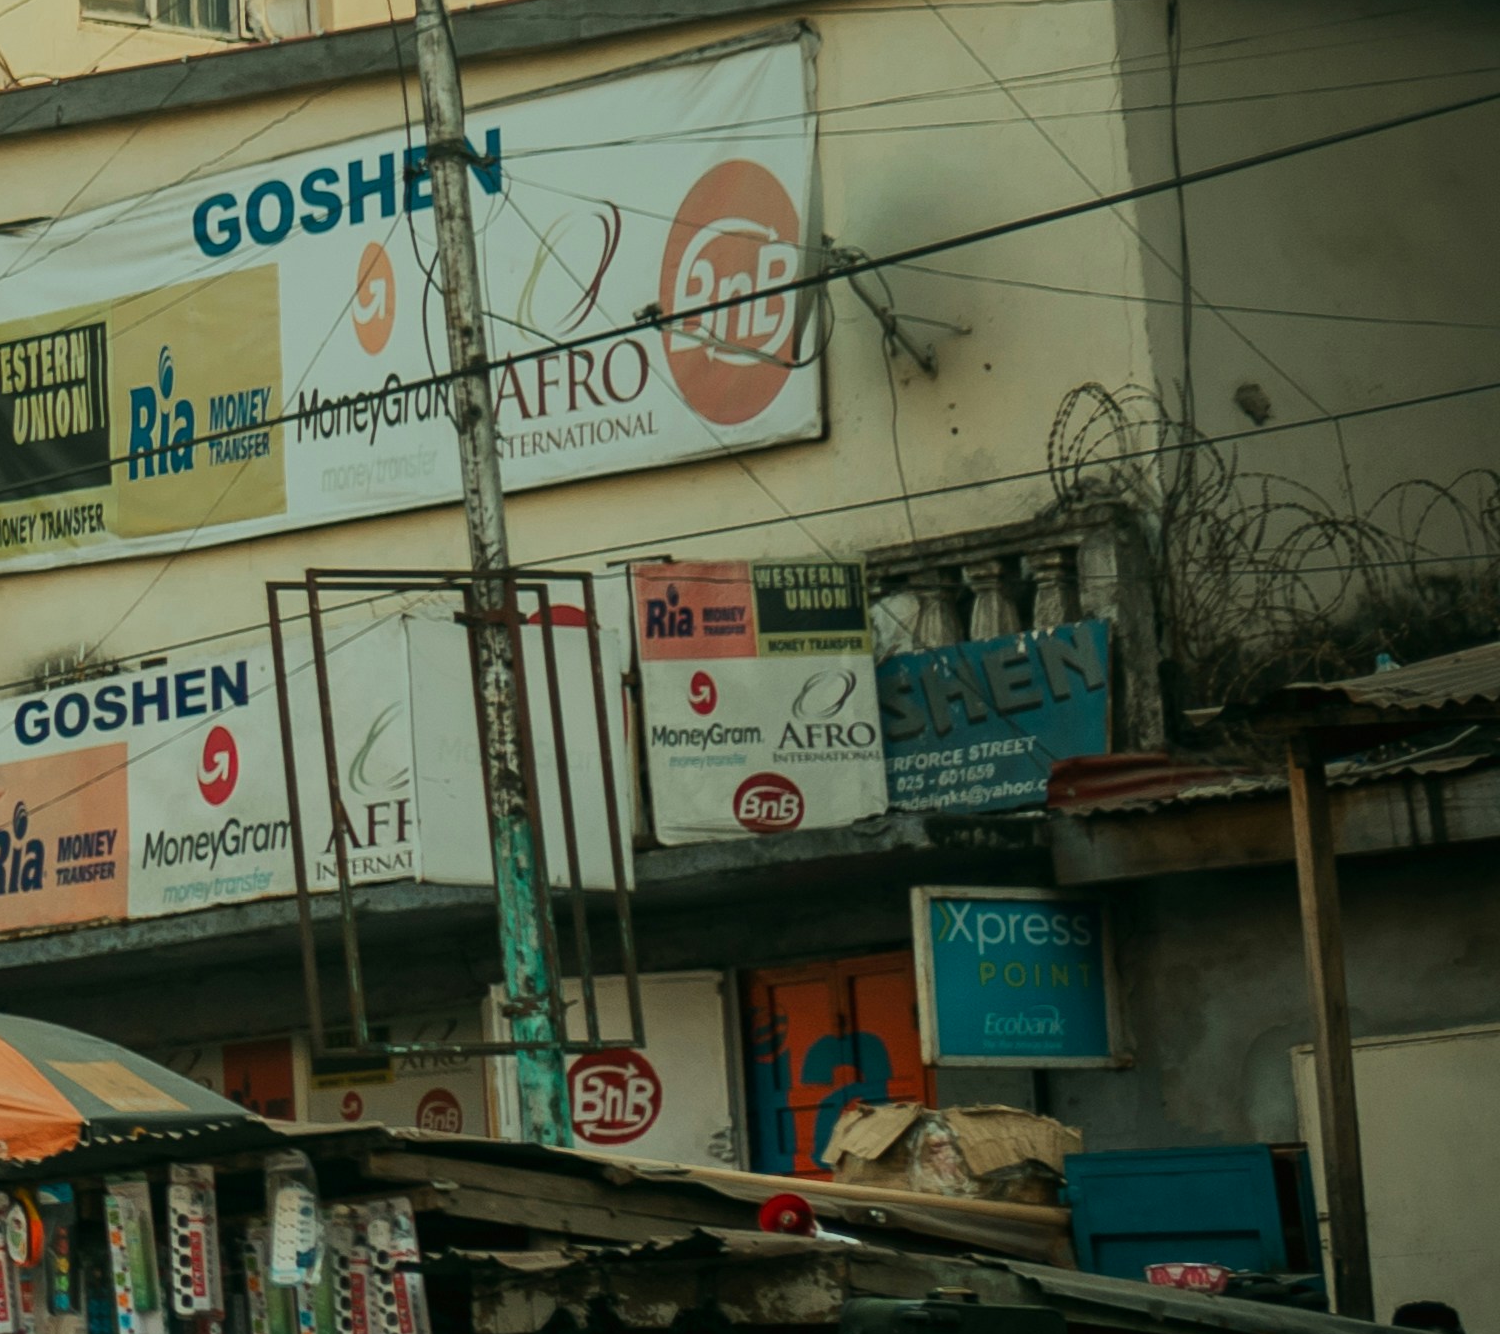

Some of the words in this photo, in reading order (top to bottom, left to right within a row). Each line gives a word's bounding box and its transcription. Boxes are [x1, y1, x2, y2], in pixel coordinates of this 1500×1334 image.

[668, 241, 800, 355] BnB
[494, 338, 651, 423] AFRO
[12, 378, 88, 446] UNION
[128, 365, 195, 482] Ria
[208, 386, 272, 431] MONEY
[208, 431, 270, 467] TRANSFER
[494, 409, 660, 461] NTERNATIONAL
[39, 503, 106, 539] TRANSFER
[754, 565, 846, 589] WESTERN
[646, 589, 695, 639] Ria
[702, 606, 746, 623] MONEY
[785, 586, 847, 611] UNION
[768, 638, 806, 653] MONEY
[807, 634, 864, 652] TRANSFER
[882, 623, 1106, 742] SHEN
[13, 659, 251, 747] GOSHEN
[779, 720, 877, 750] AFRO
[968, 735, 1038, 762] STREET
[772, 750, 882, 765] INTERNATIONAL
[738, 791, 800, 823] BnB
[56, 829, 117, 864] MONEY
[142, 816, 294, 871] MoneyGram
[55, 862, 116, 886] TRANSFER
[161, 880, 213, 905] money
[213, 866, 273, 897] transfer
[946, 901, 1093, 956] Xpress
[978, 961, 1092, 988] POINT
[983, 1010, 1067, 1036] Ecobank
[573, 1075, 655, 1129] BnB
